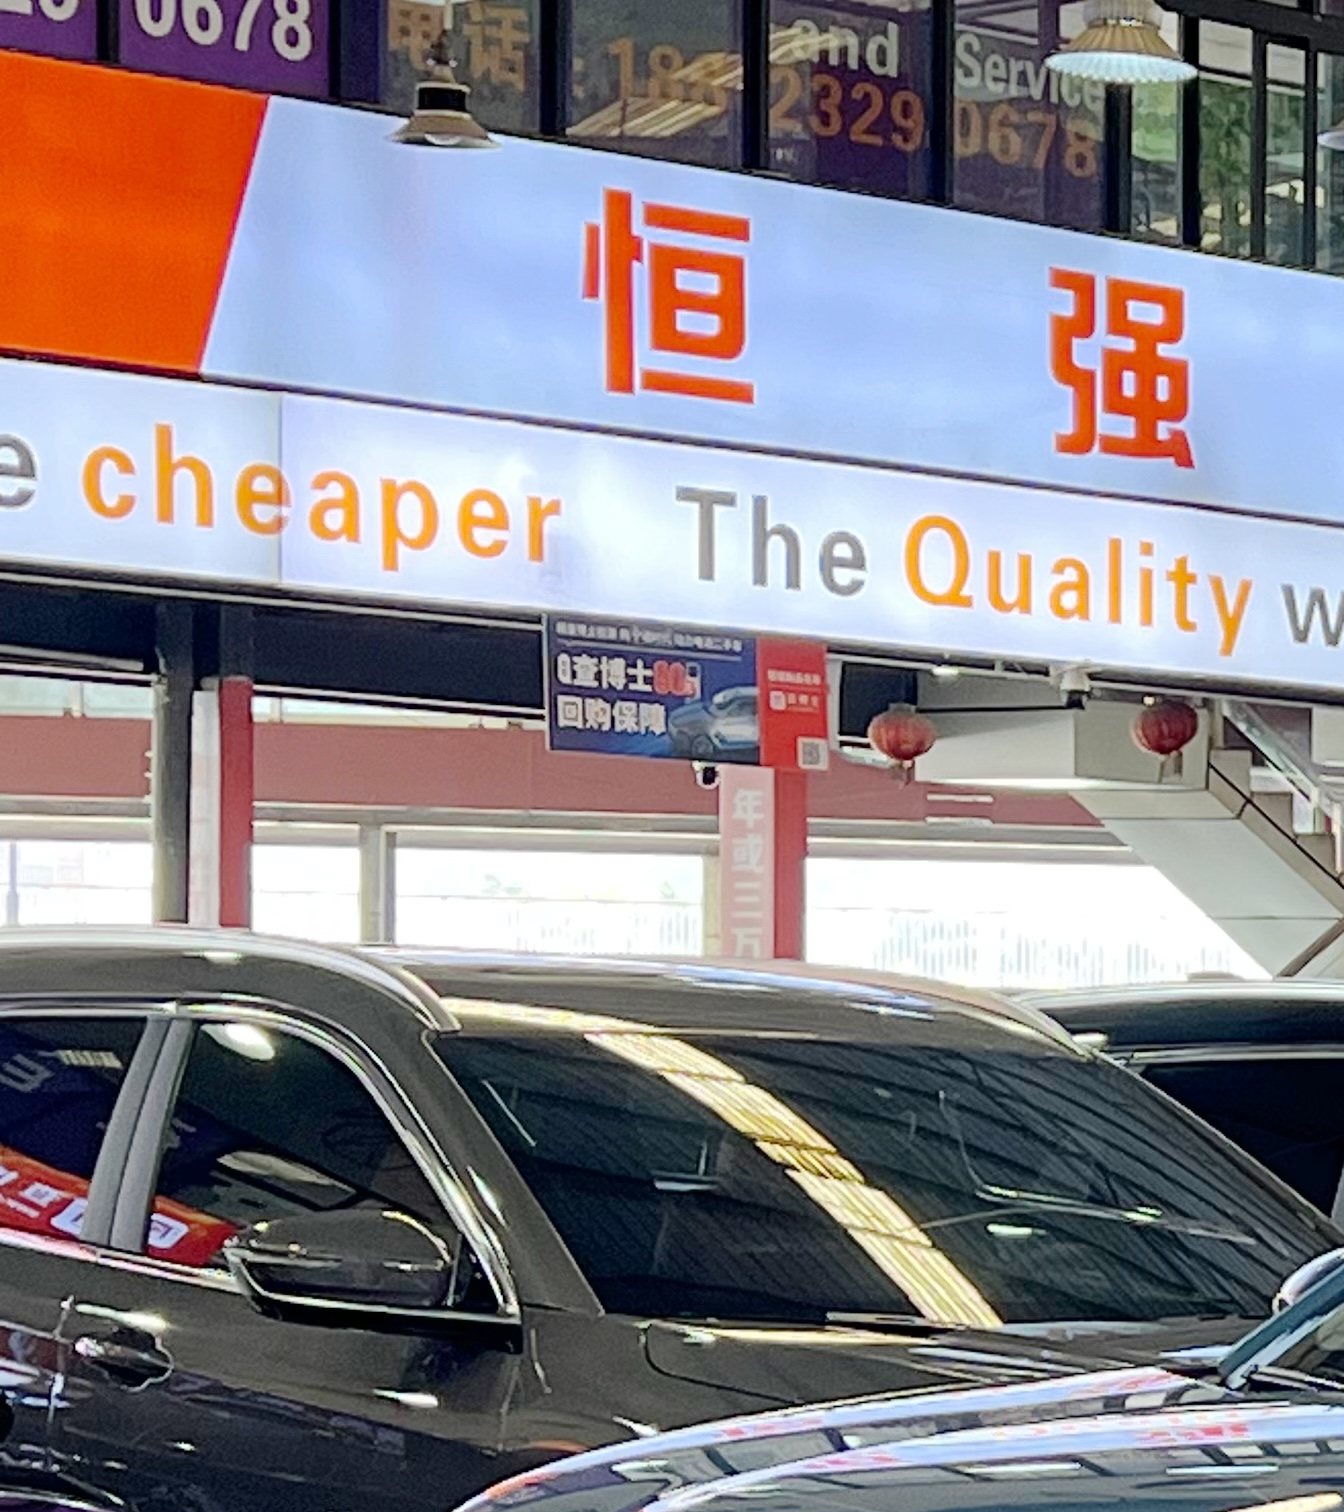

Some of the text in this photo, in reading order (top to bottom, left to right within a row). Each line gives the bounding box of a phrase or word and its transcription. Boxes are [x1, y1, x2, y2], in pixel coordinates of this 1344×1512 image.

[768, 66, 924, 152] 2329
[954, 100, 1099, 179] 0678
[82, 423, 562, 572] cheaper
[675, 485, 868, 598] The
[904, 514, 1254, 657] Quality
